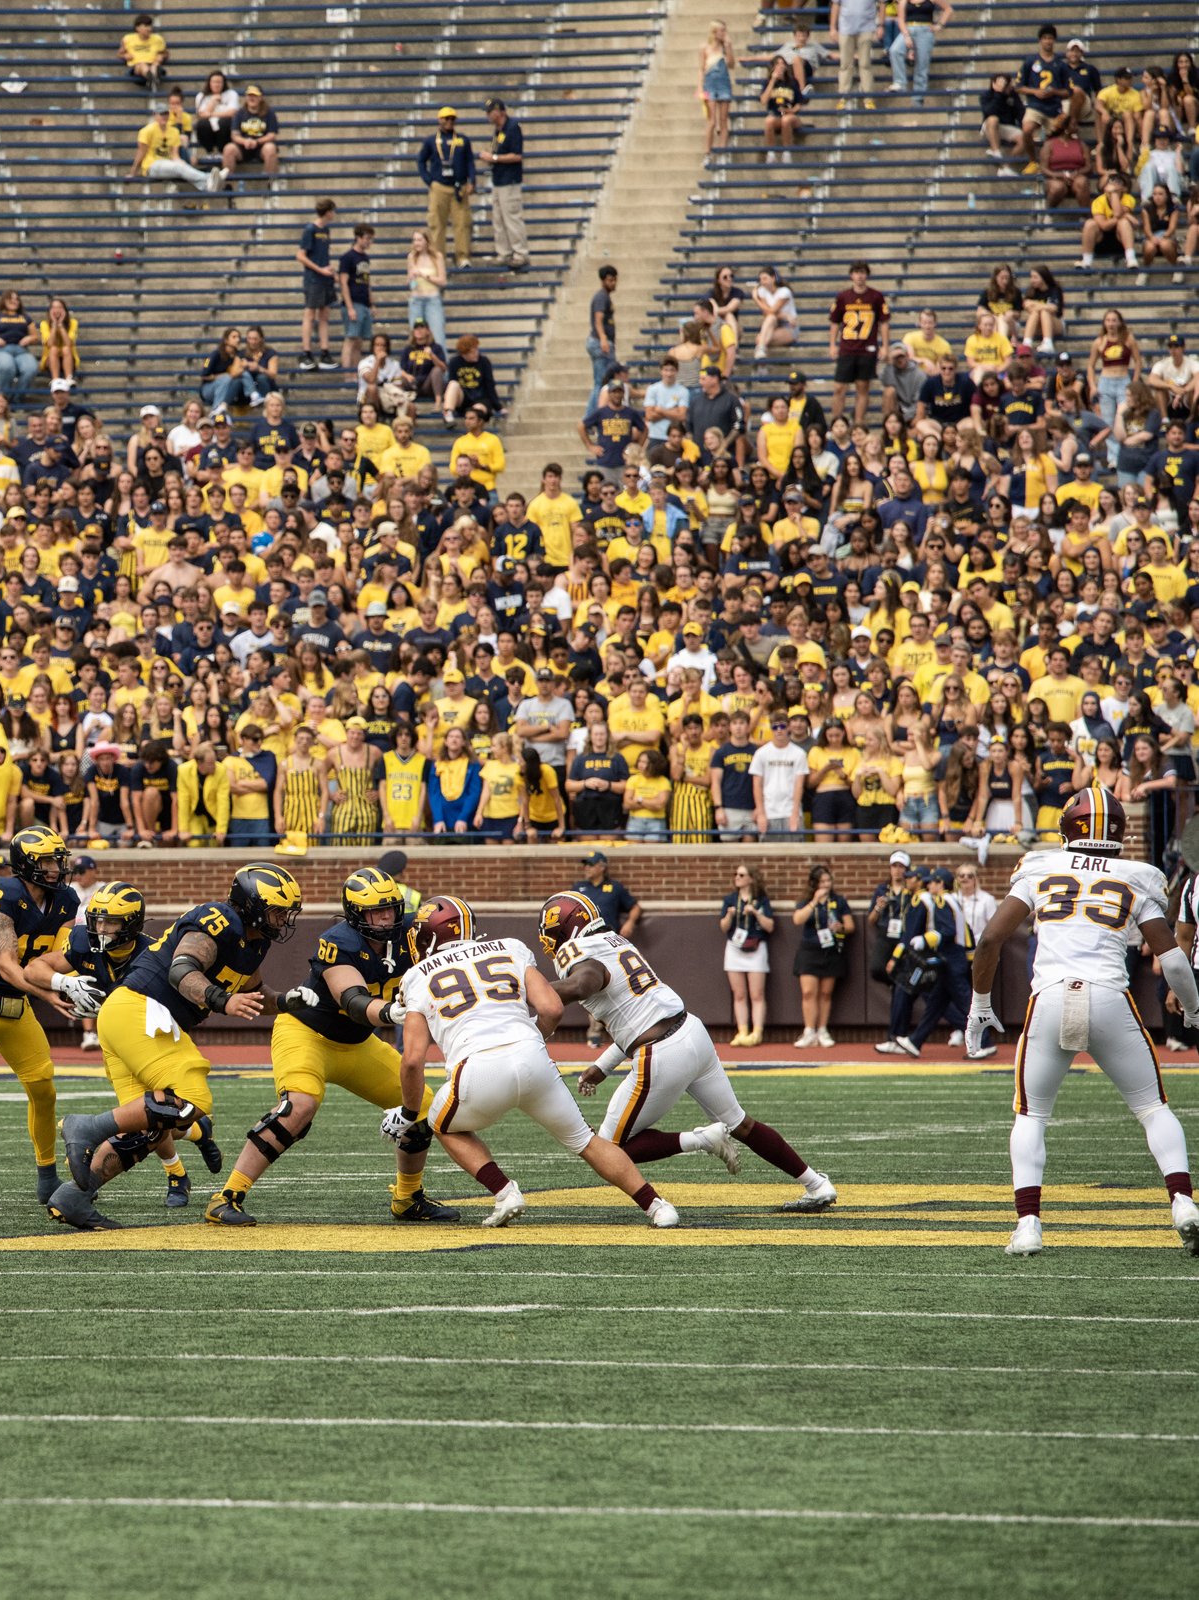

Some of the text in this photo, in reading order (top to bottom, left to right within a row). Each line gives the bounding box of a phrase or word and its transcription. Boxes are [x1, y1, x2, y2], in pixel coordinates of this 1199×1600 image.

[842, 311, 875, 340] 27
[504, 534, 528, 559] 12
[903, 651, 933, 665] 2023
[391, 784, 413, 800] 23
[1070, 855, 1112, 873] EARL
[1035, 874, 1137, 932] 33
[199, 907, 230, 936] 75
[317, 938, 338, 964] 60
[419, 940, 507, 976] VAN WETZINGA
[555, 941, 585, 970] 81
[428, 955, 522, 1020] 95
